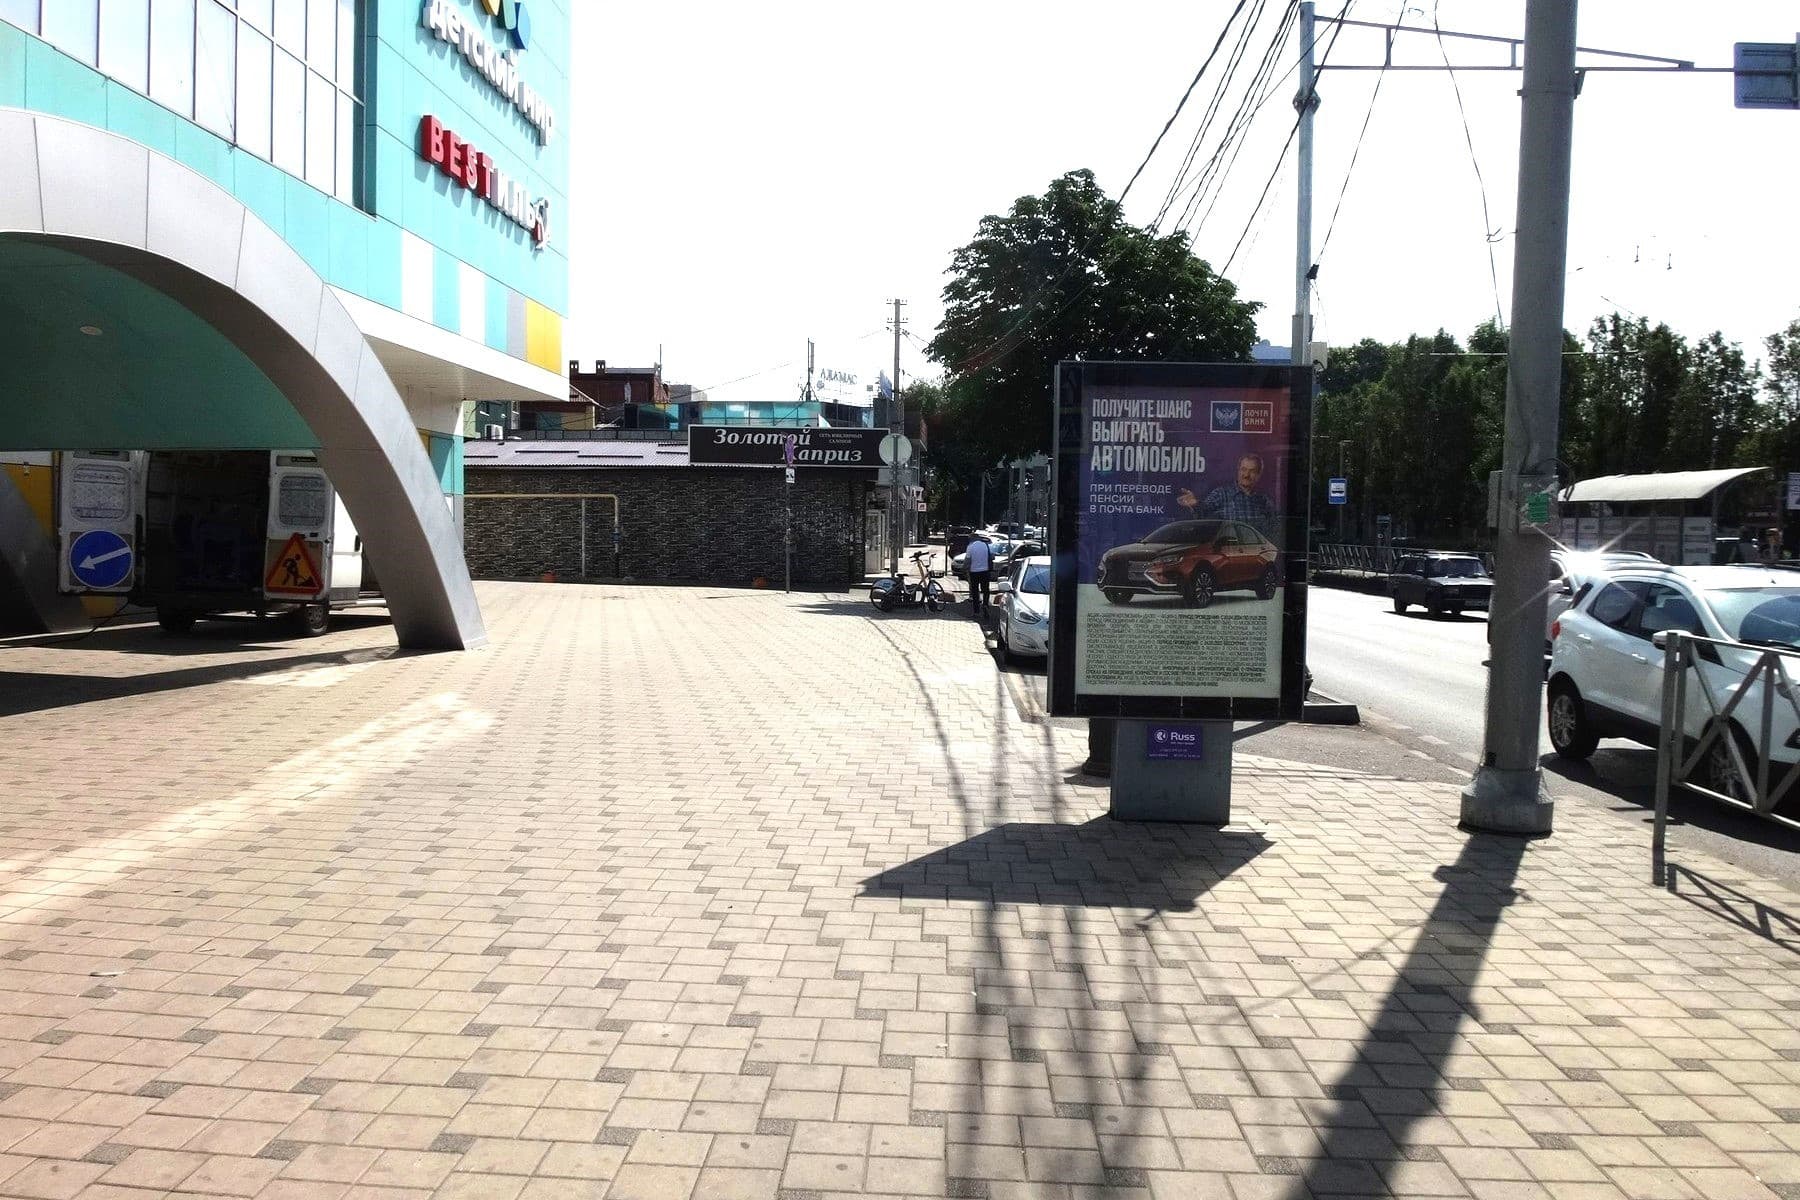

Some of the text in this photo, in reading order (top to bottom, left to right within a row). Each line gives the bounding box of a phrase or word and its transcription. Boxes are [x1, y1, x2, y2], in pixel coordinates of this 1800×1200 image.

[1092, 399, 1193, 419] ПОЛУЧИТЕ ШАНС
[1092, 421, 1165, 443] ВЫИГРАТЬ
[1090, 445, 1206, 473] АВТОМОБИЛЬ
[1089, 483, 1172, 494] ПРИ ПЕРЕВОДЕ
[1089, 494, 1135, 503] ПЕНСИИ
[1089, 504, 1165, 514] В ПОЧТА БАНК
[1170, 731, 1196, 741] Russ
